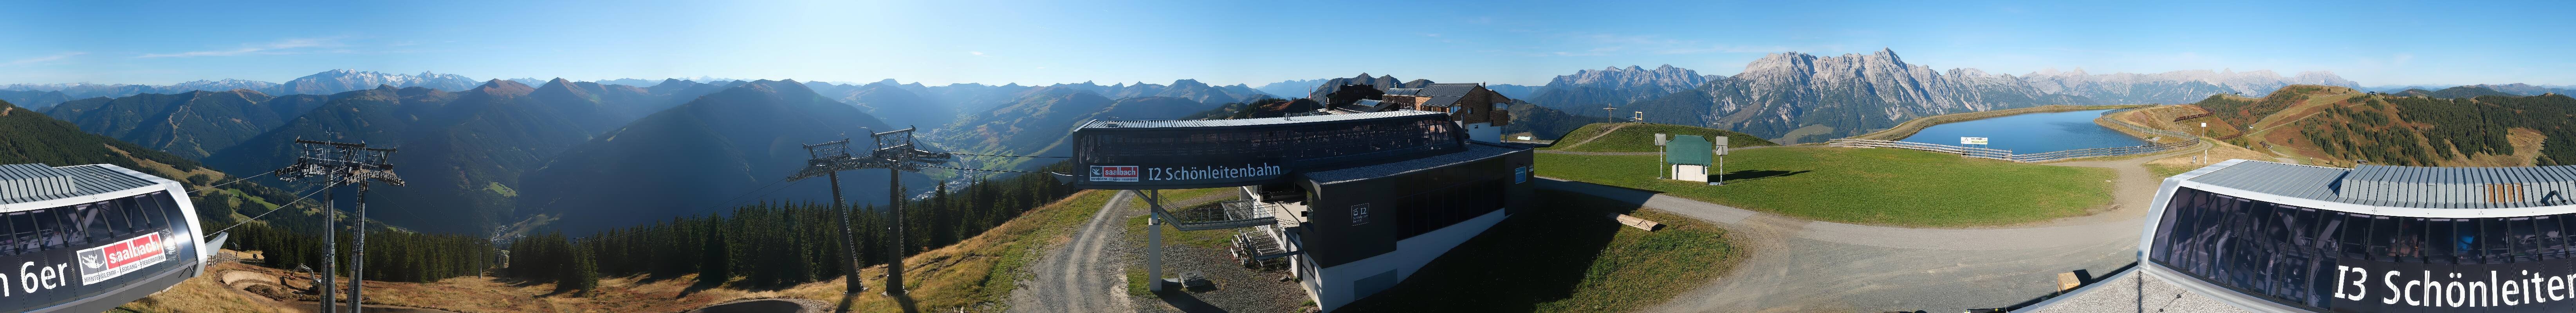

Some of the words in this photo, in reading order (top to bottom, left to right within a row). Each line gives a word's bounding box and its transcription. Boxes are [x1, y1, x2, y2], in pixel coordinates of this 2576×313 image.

[1105, 167, 1136, 175] saalbach
[1149, 167, 1161, 180] I2
[1166, 163, 1280, 180] Schönleitenbahn
[109, 236, 161, 264] saalbach
[21, 261, 67, 293] 6er
[121, 263, 137, 273] LEOGANG
[2334, 265, 2367, 301] I3
